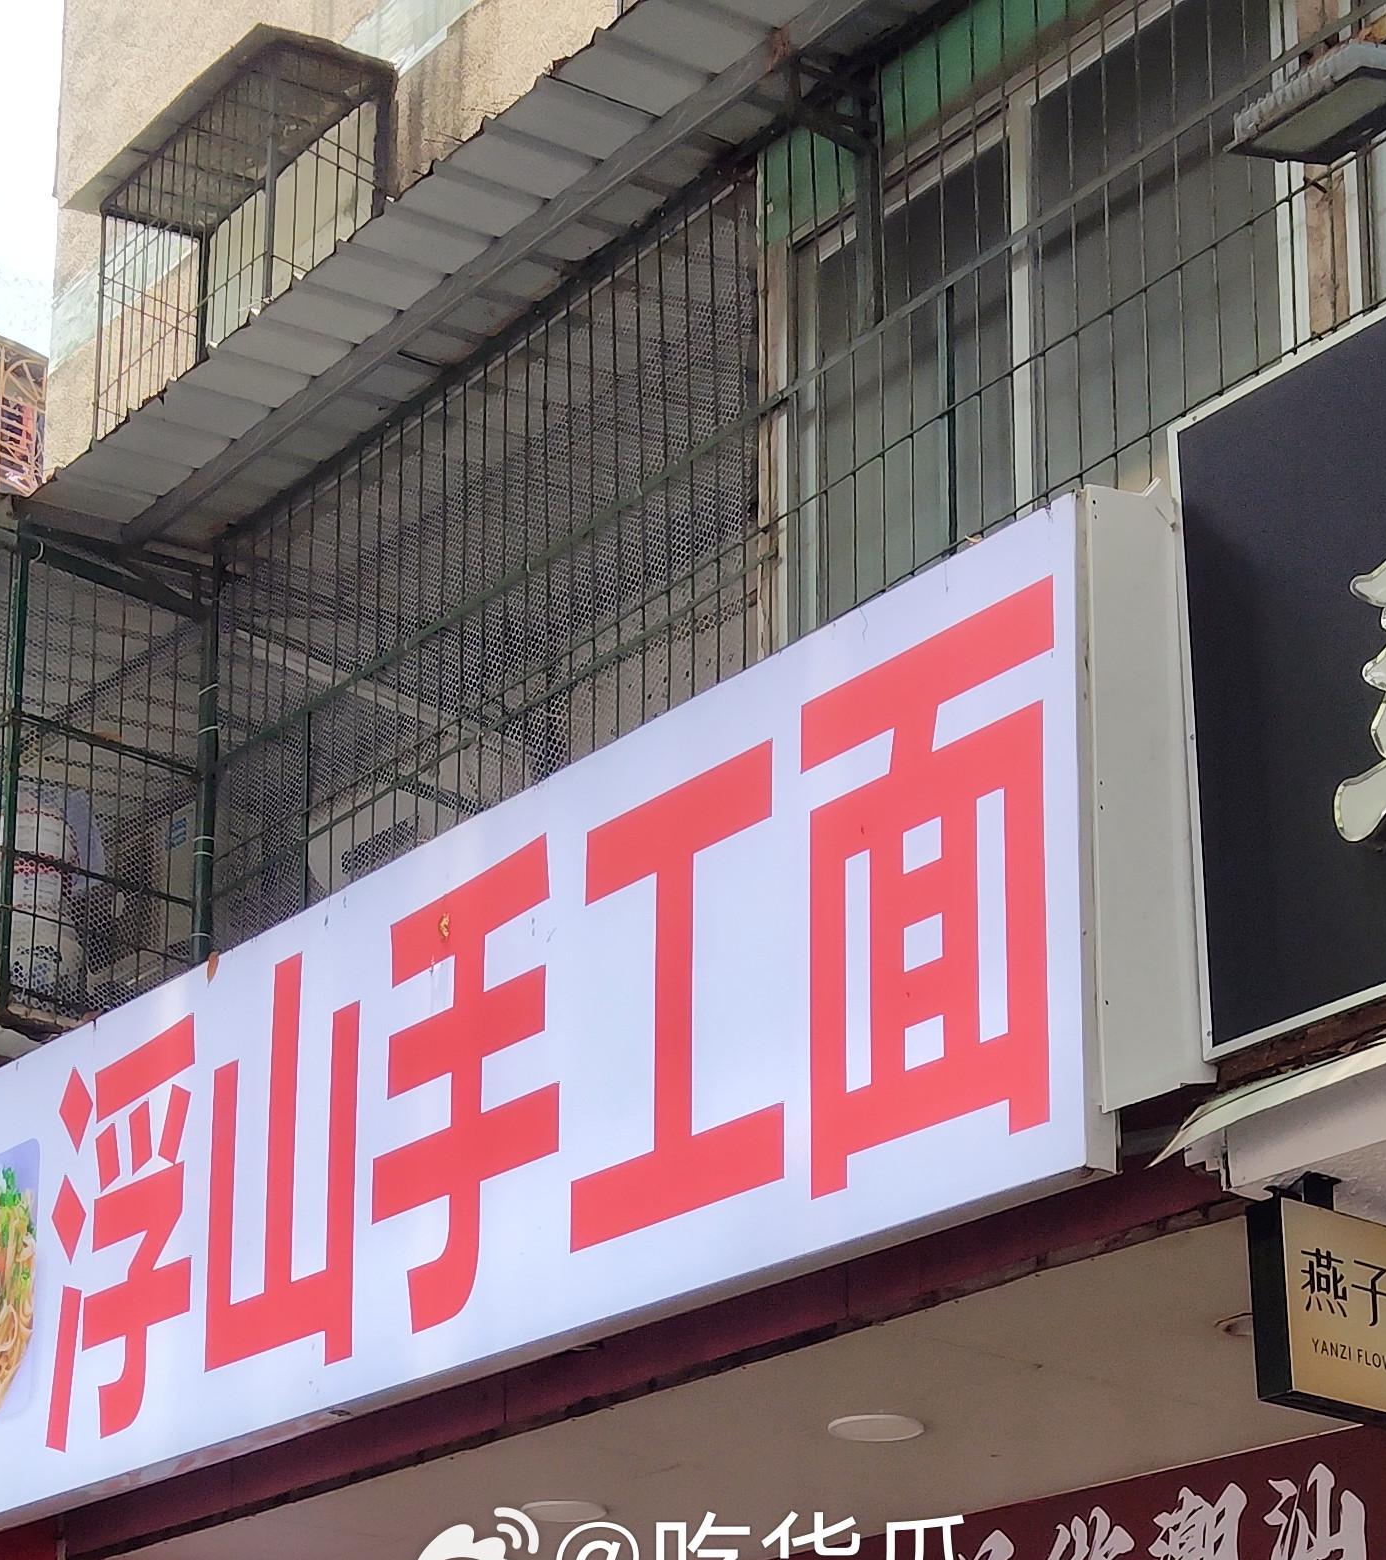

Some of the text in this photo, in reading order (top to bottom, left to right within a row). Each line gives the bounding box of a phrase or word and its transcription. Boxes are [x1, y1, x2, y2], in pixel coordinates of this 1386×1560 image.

[45, 574, 1055, 1452] 浮山手工面
[1312, 1338, 1352, 1361] YANZI
